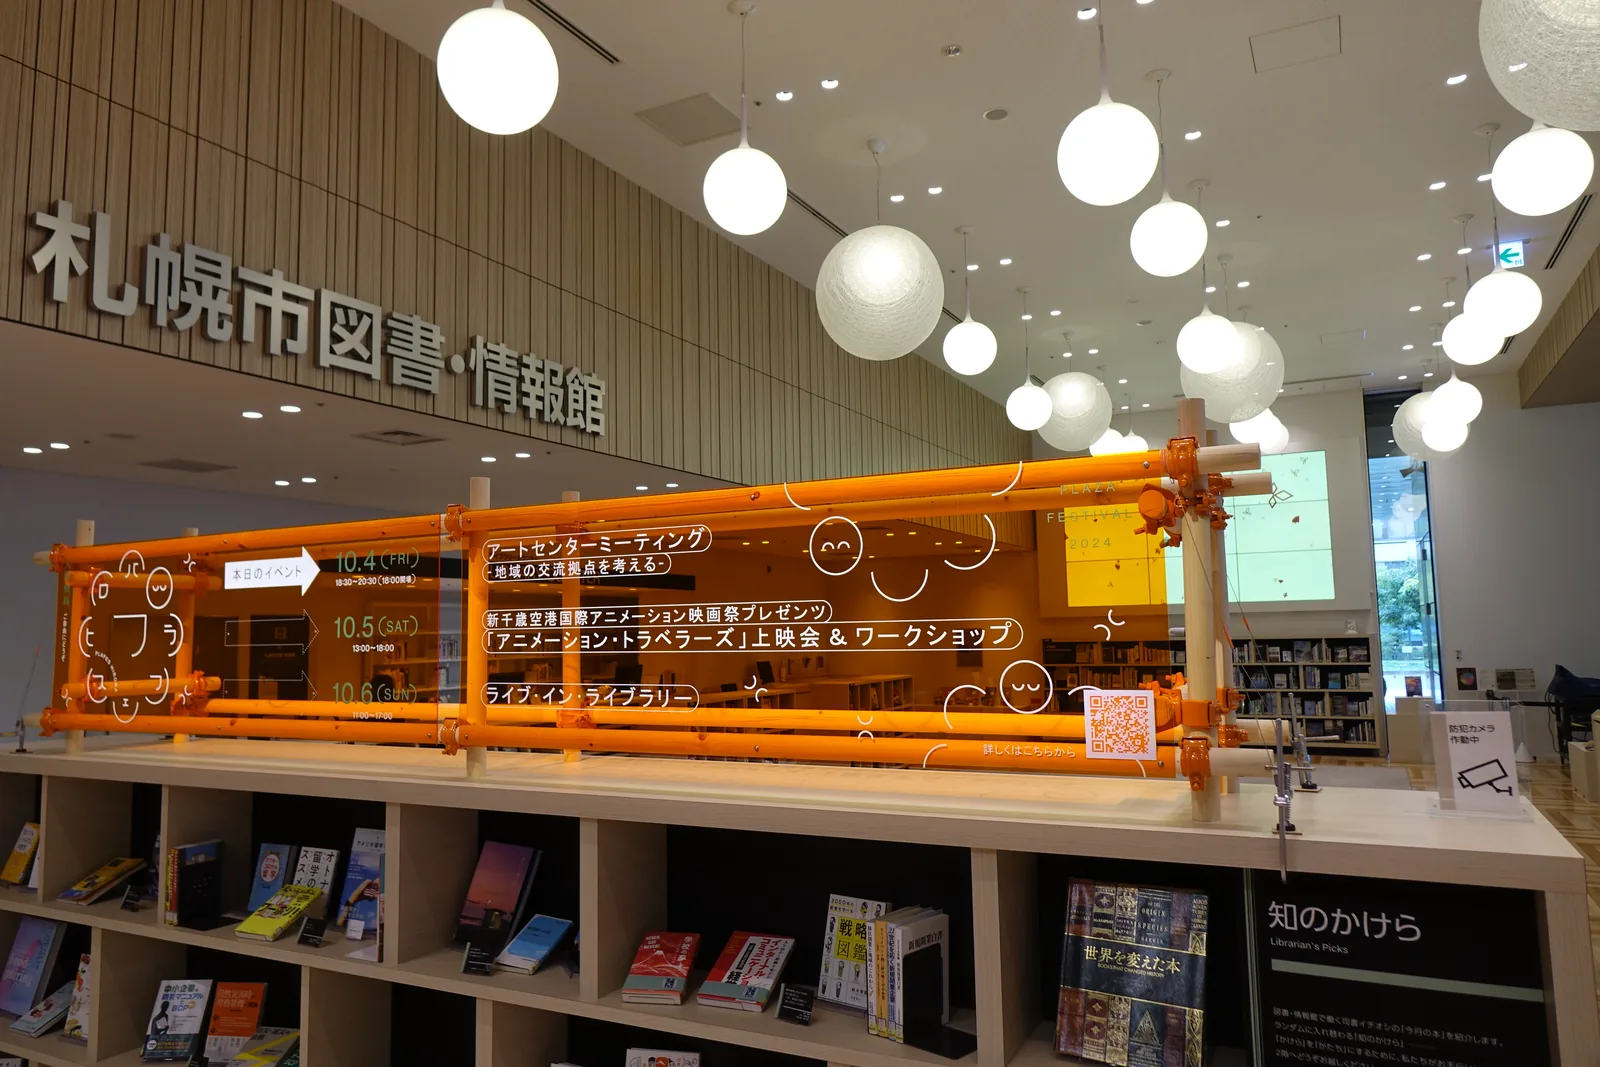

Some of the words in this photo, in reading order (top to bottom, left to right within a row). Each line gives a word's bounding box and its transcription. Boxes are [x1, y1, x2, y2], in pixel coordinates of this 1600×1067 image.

[32, 200, 606, 436] 札幌市図書・情報館
[1060, 481, 1116, 495] PLAZA
[1047, 508, 1132, 523] FESTIVAL
[487, 526, 708, 560] アートセンターミーティング
[1070, 537, 1111, 549] 2024
[336, 549, 376, 572] 10.4
[232, 565, 302, 580] 本日のイベント
[487, 604, 827, 628] 新千歳空港国際アニメーション映画祭プレゼンツ
[334, 616, 374, 639] 10.5
[856, 620, 1012, 646] ワークショップ
[333, 682, 373, 705] 10.6
[487, 687, 693, 708] ライブ・イン・ライブラリー
[1449, 724, 1496, 734] 防犯カメラ
[1450, 735, 1479, 745] 作動中
[983, 743, 1076, 758] 詳しくはこちらから
[307, 850, 321, 888] 留学の
[839, 918, 866, 939] 戦略
[1268, 900, 1421, 942] 知のかけら
[837, 940, 866, 962] 図鑑
[1270, 937, 1320, 951] Librarian's
[1322, 943, 1349, 955] Picks
[1084, 945, 1181, 974] 世界を変えた本
